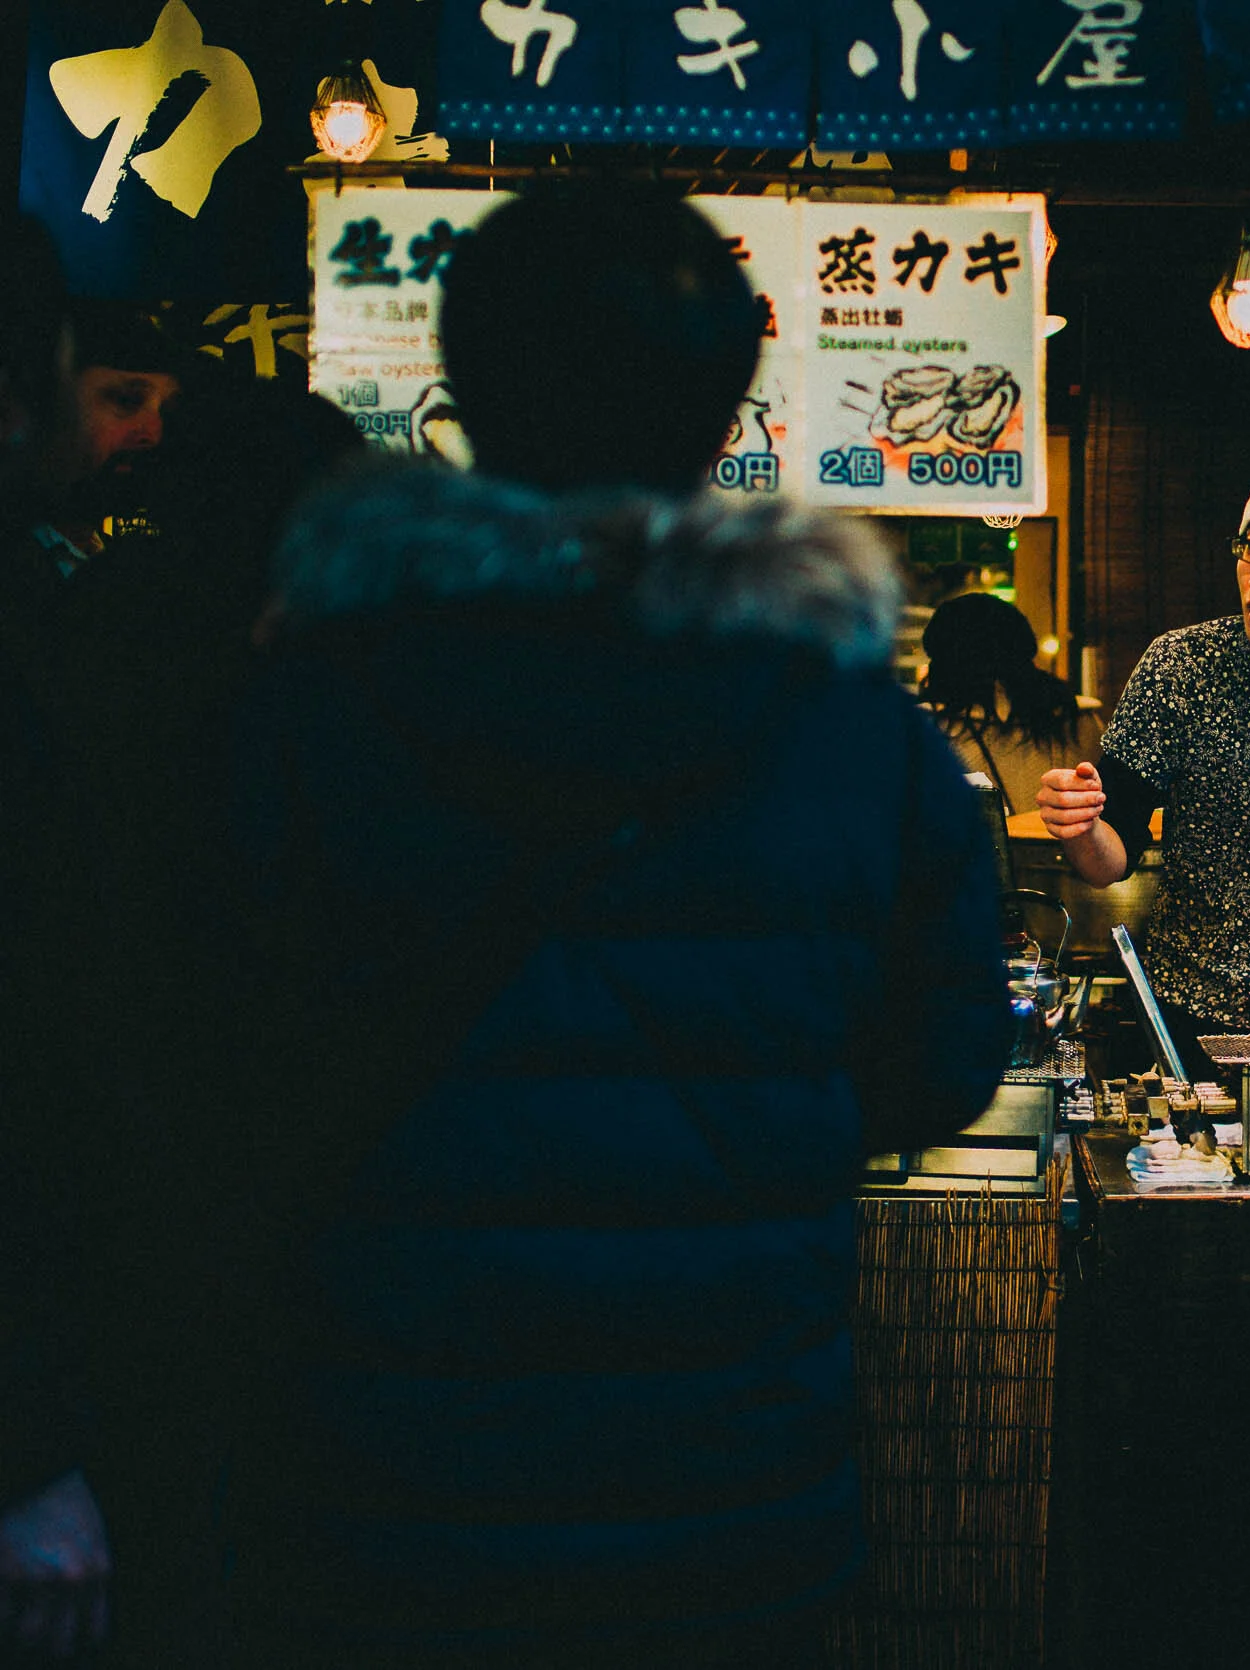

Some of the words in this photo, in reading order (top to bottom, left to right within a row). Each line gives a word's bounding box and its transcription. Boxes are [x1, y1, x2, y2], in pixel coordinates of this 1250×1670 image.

[480, 0, 1148, 100] カキ小屋
[818, 227, 1021, 294] 蒸カキ
[334, 300, 429, 322] 本品牌
[817, 333, 896, 351] Steamed
[902, 336, 968, 354] oysters
[350, 410, 411, 436] 00円
[708, 452, 779, 492] 0円
[818, 448, 884, 487] 2個
[906, 450, 1022, 488] 500円
